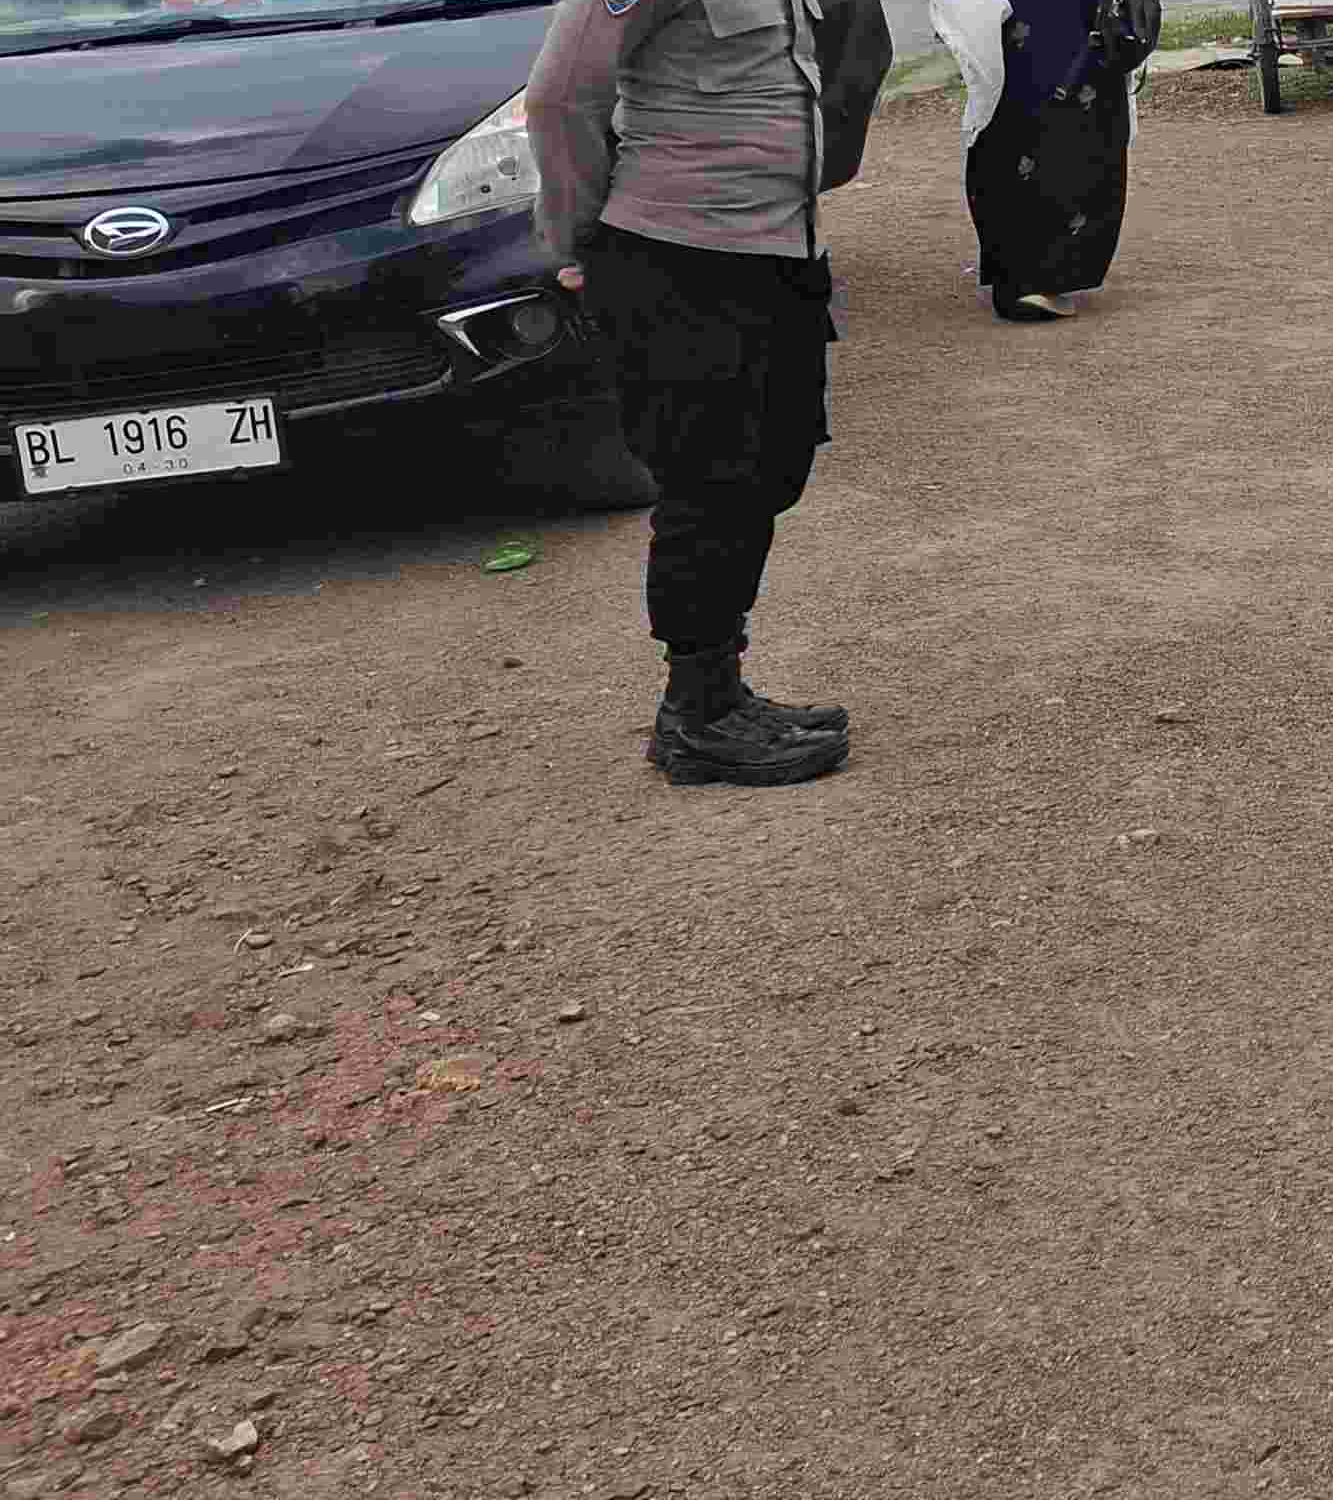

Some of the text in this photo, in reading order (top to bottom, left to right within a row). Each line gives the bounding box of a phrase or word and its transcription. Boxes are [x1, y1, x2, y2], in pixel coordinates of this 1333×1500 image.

[25, 404, 273, 466] BL 1916 ZH
